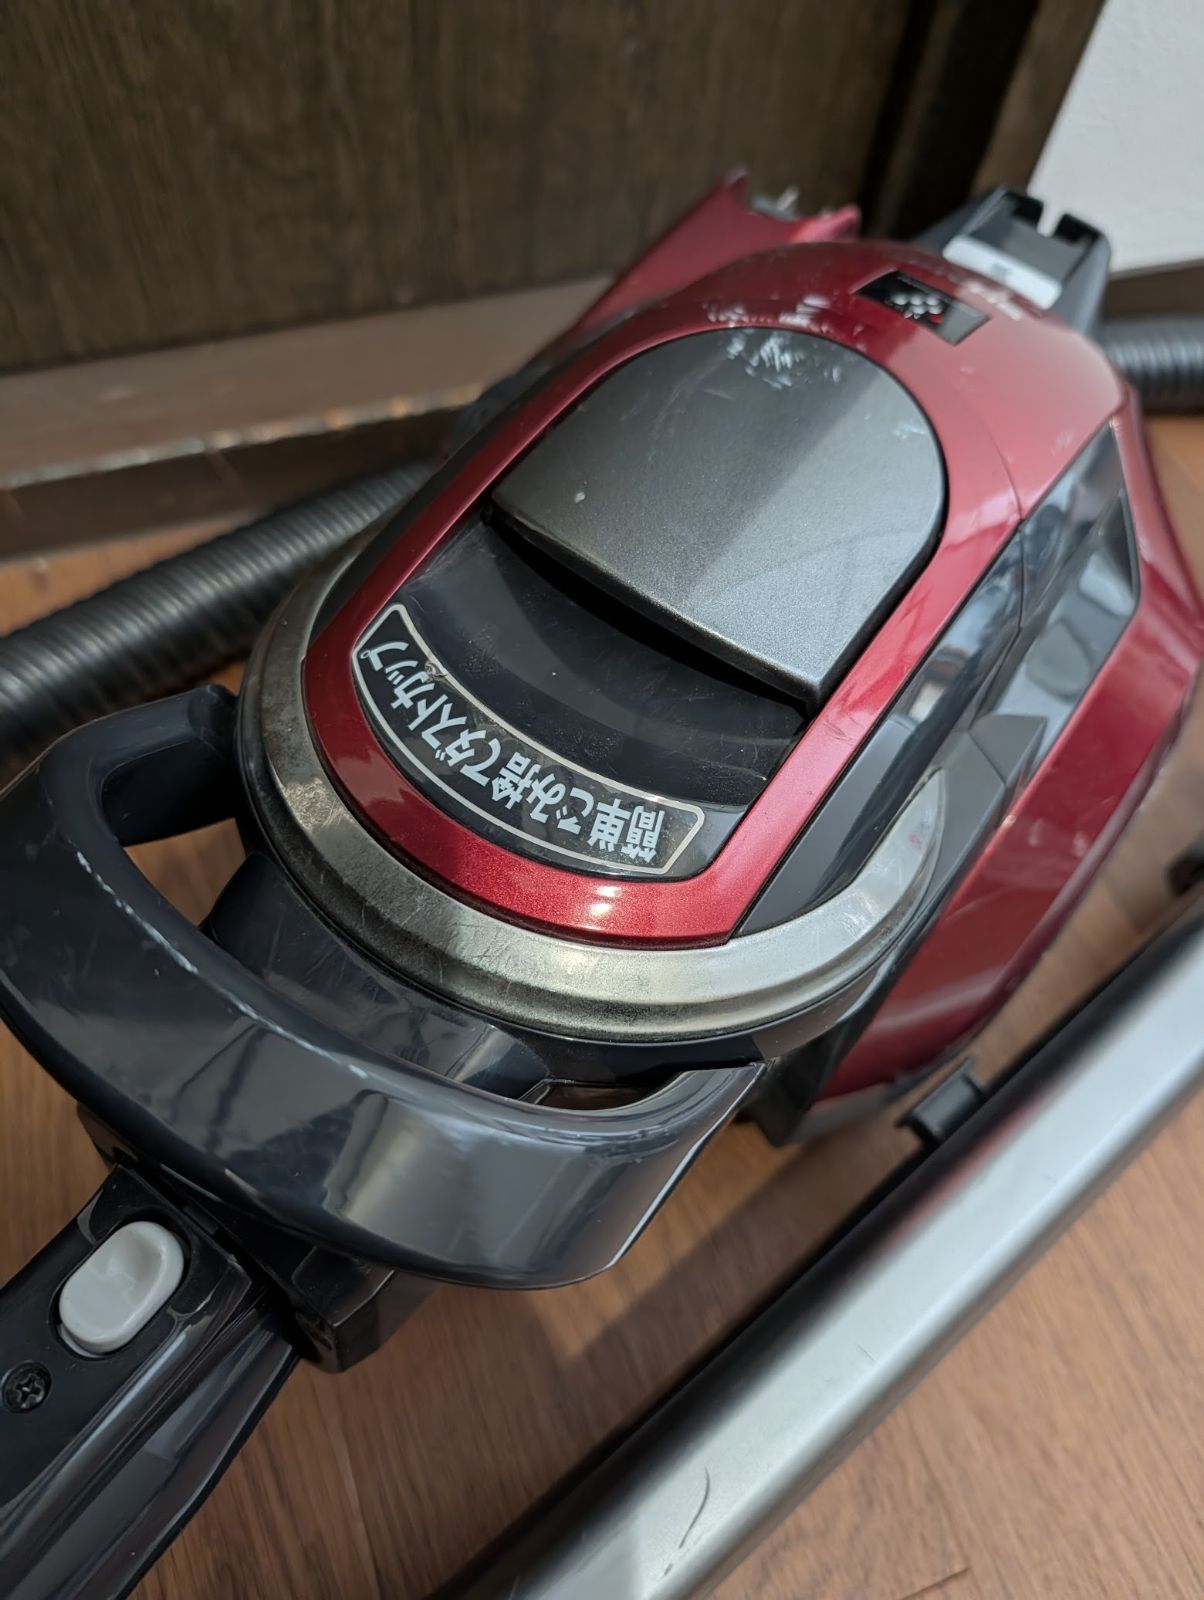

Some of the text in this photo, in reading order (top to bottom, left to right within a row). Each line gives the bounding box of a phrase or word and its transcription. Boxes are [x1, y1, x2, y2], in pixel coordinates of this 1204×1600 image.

[360, 641, 665, 863] 簡単ごみ捨てダストカップ
